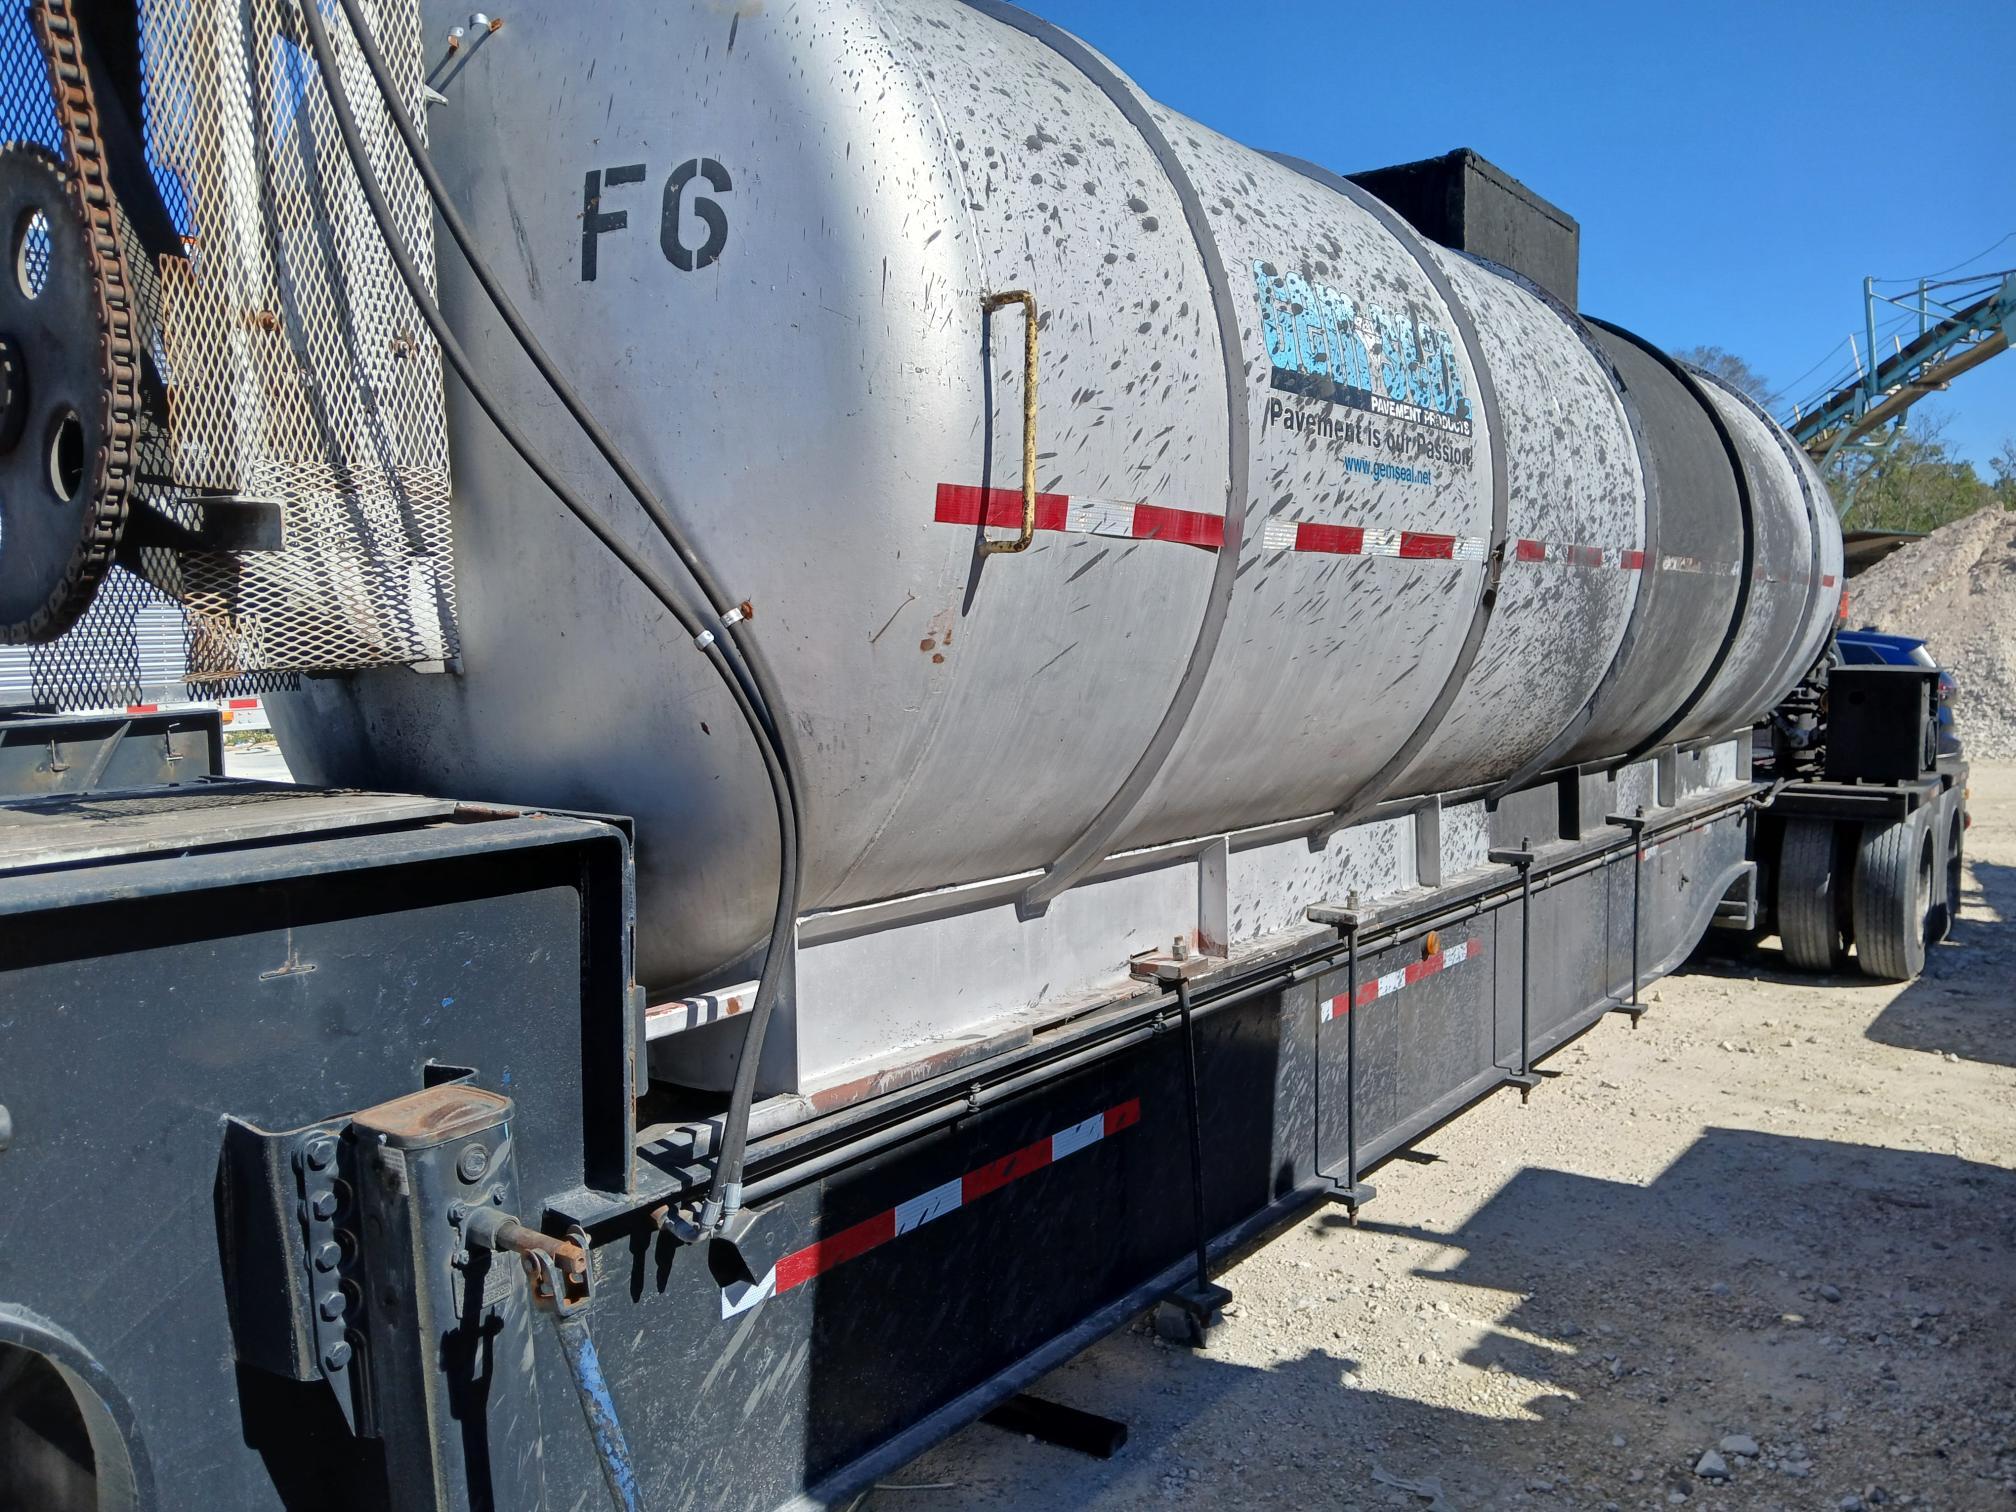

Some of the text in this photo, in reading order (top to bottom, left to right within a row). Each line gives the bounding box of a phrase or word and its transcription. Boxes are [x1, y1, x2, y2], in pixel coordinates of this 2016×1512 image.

[581, 158, 732, 281] F6
[1270, 397, 1362, 444] Pavement
[1367, 420, 1381, 448] is
[1387, 429, 1412, 454] our
[1371, 396, 1470, 435] PAVEMENT PRODUCTS
[1344, 456, 1432, 485] www.gemseal.net
